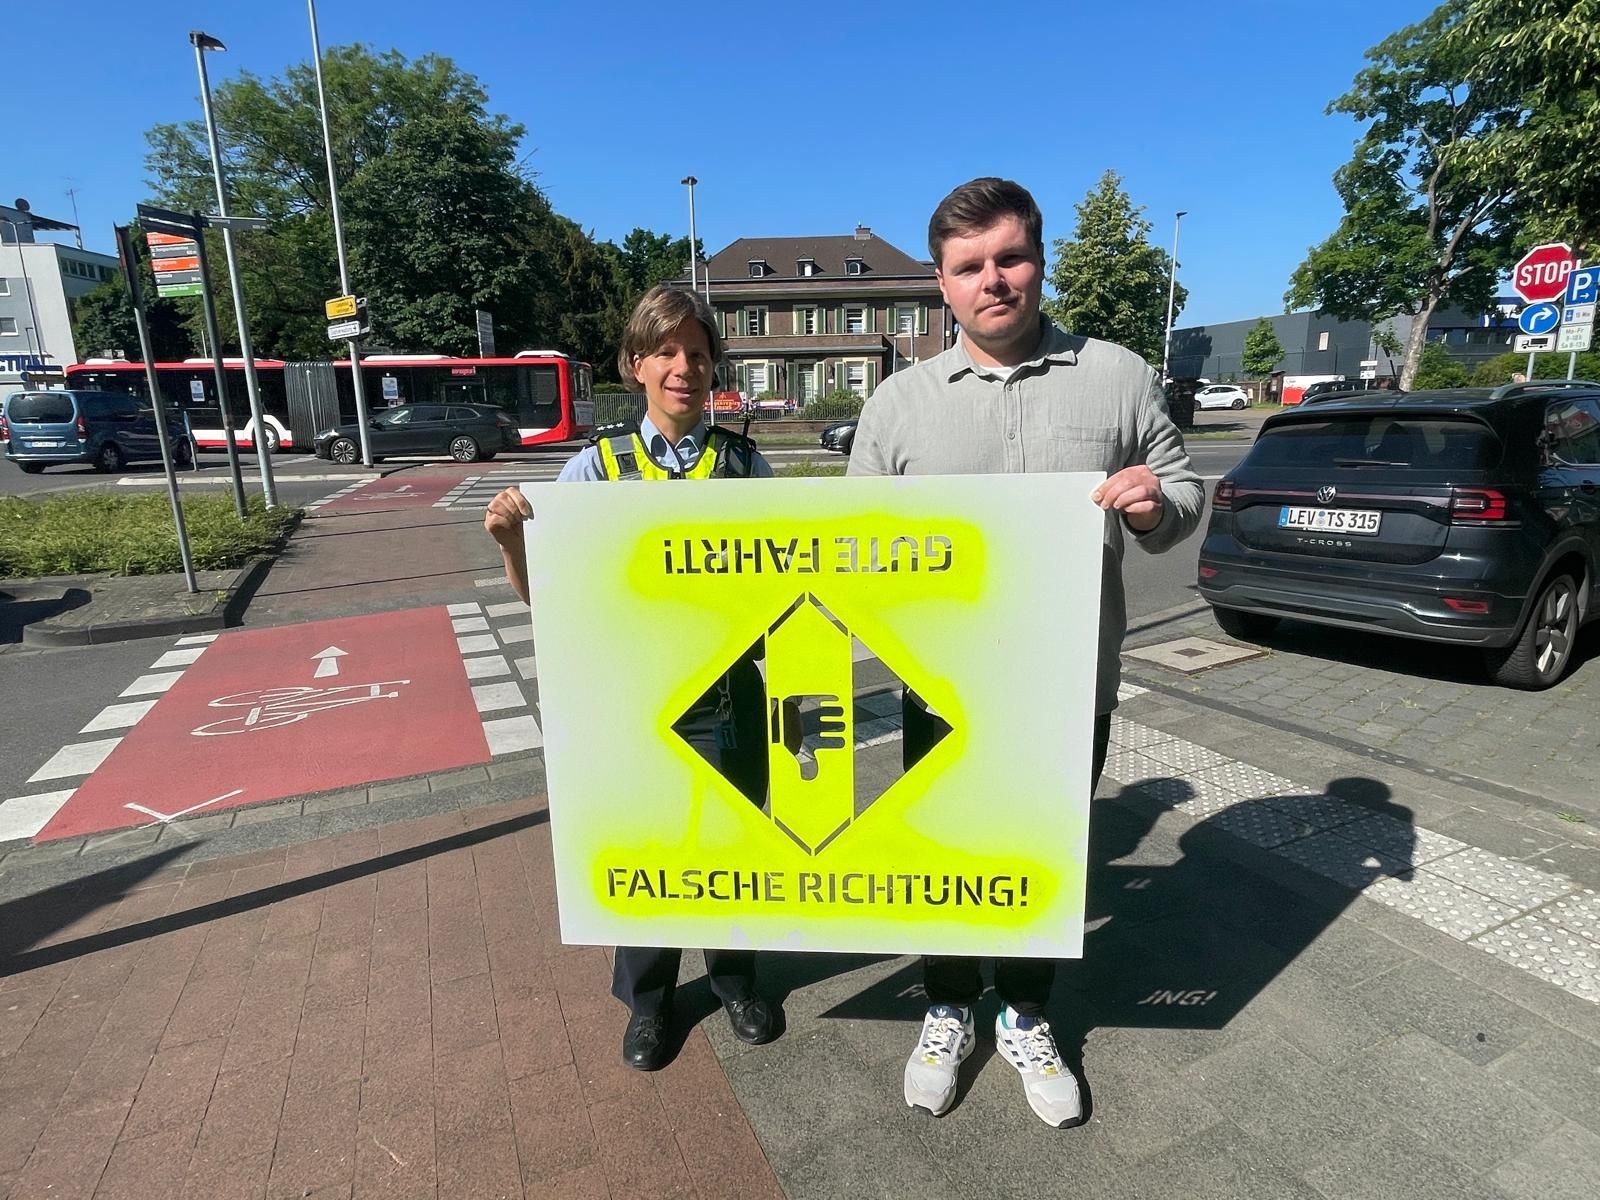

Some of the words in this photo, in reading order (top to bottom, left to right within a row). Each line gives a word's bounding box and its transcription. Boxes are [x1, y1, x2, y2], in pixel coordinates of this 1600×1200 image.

[1519, 259, 1572, 287] STOP
[1573, 272, 1593, 301] P
[1288, 509, 1316, 525] LEV
[1327, 511, 1346, 527] TS
[1348, 513, 1378, 529] 315
[664, 537, 820, 574] FAHRT!
[834, 536, 952, 573] GUTE
[1297, 537, 1352, 547] T-CROSS
[607, 867, 786, 902] FALSCHE
[798, 872, 1029, 907] RICHTUNG!
